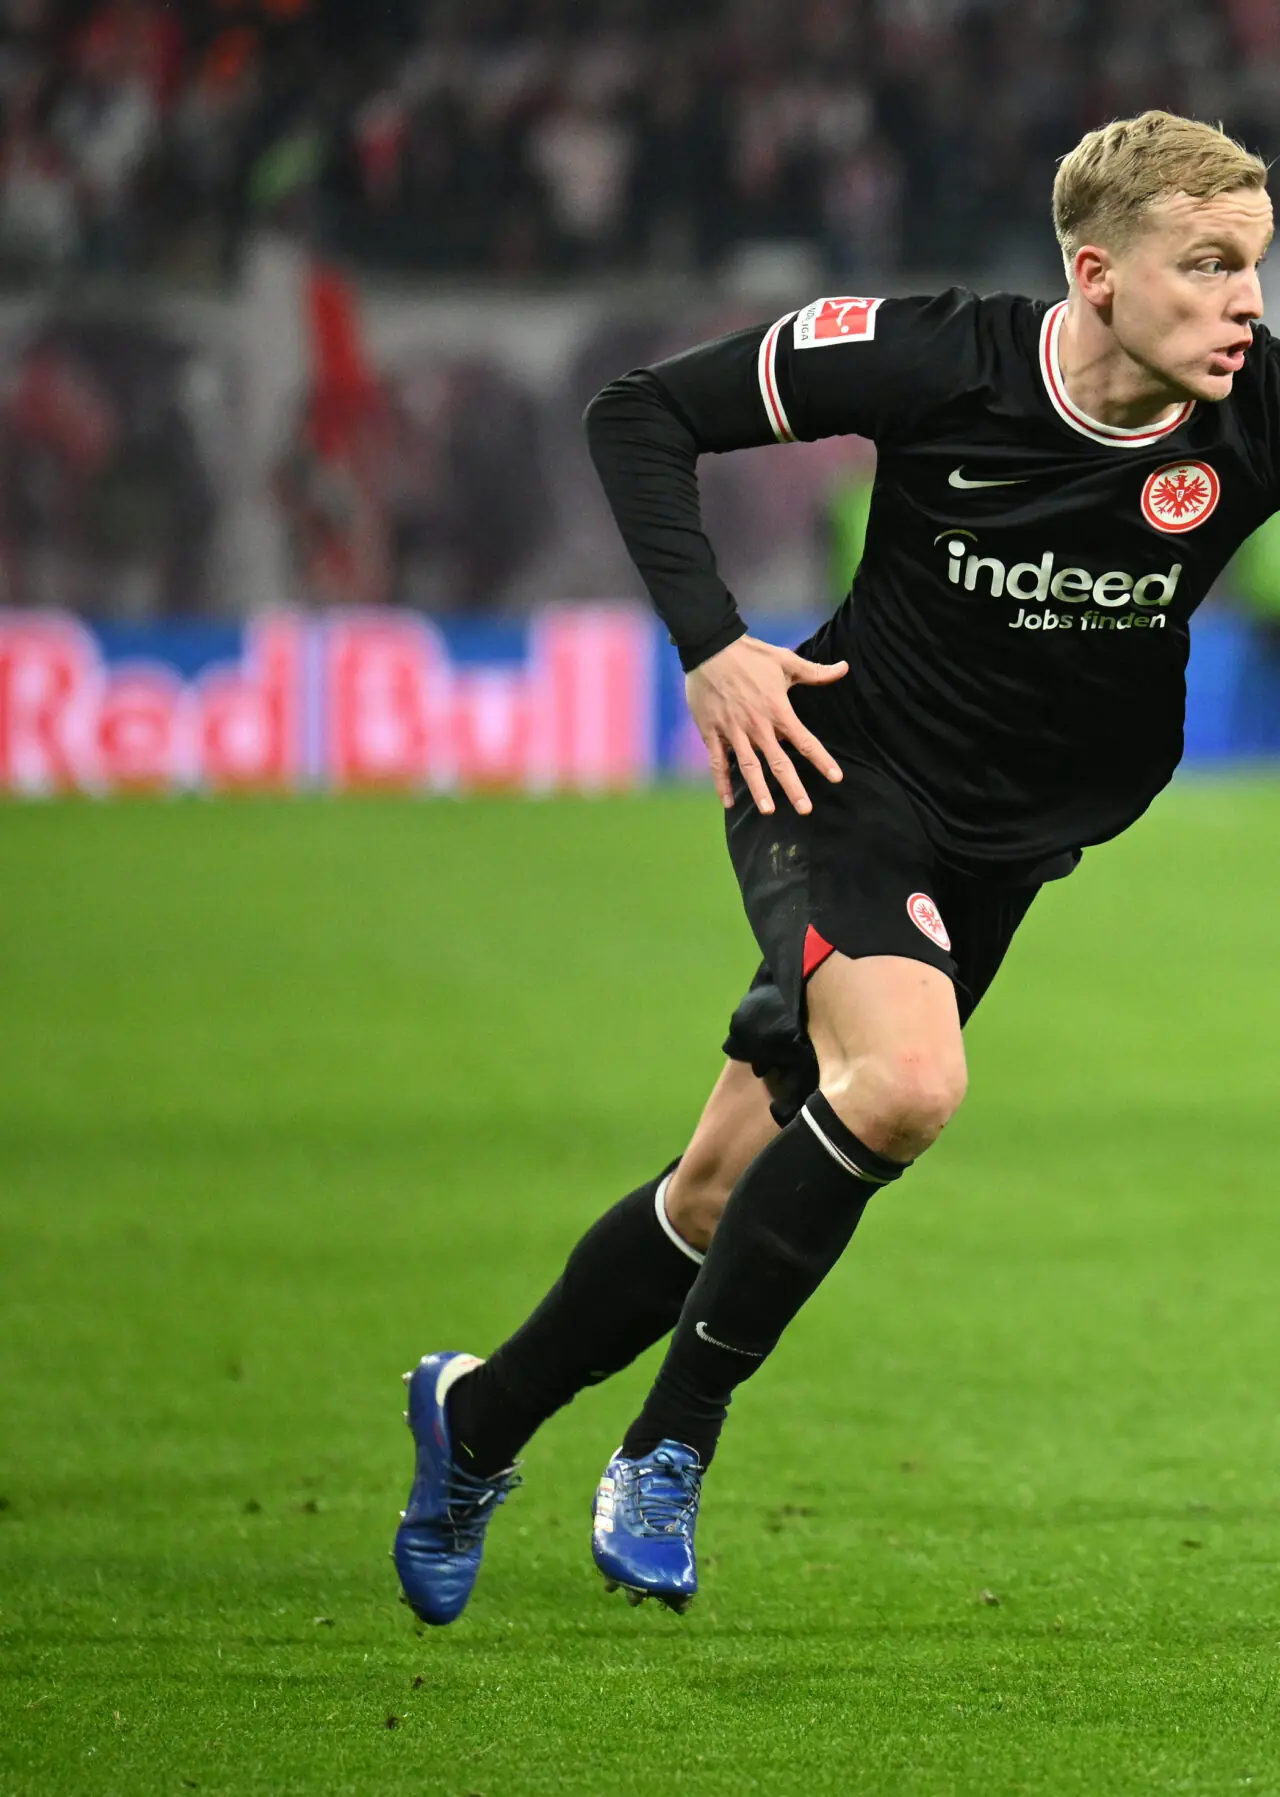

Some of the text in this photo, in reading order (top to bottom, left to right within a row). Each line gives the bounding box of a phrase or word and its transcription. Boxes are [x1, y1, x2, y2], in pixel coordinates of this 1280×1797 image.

[948, 539, 1183, 607] indeed
[1009, 608, 1166, 631] Jobs finden
[0, 608, 300, 790] Red
[325, 605, 652, 790] Bull
